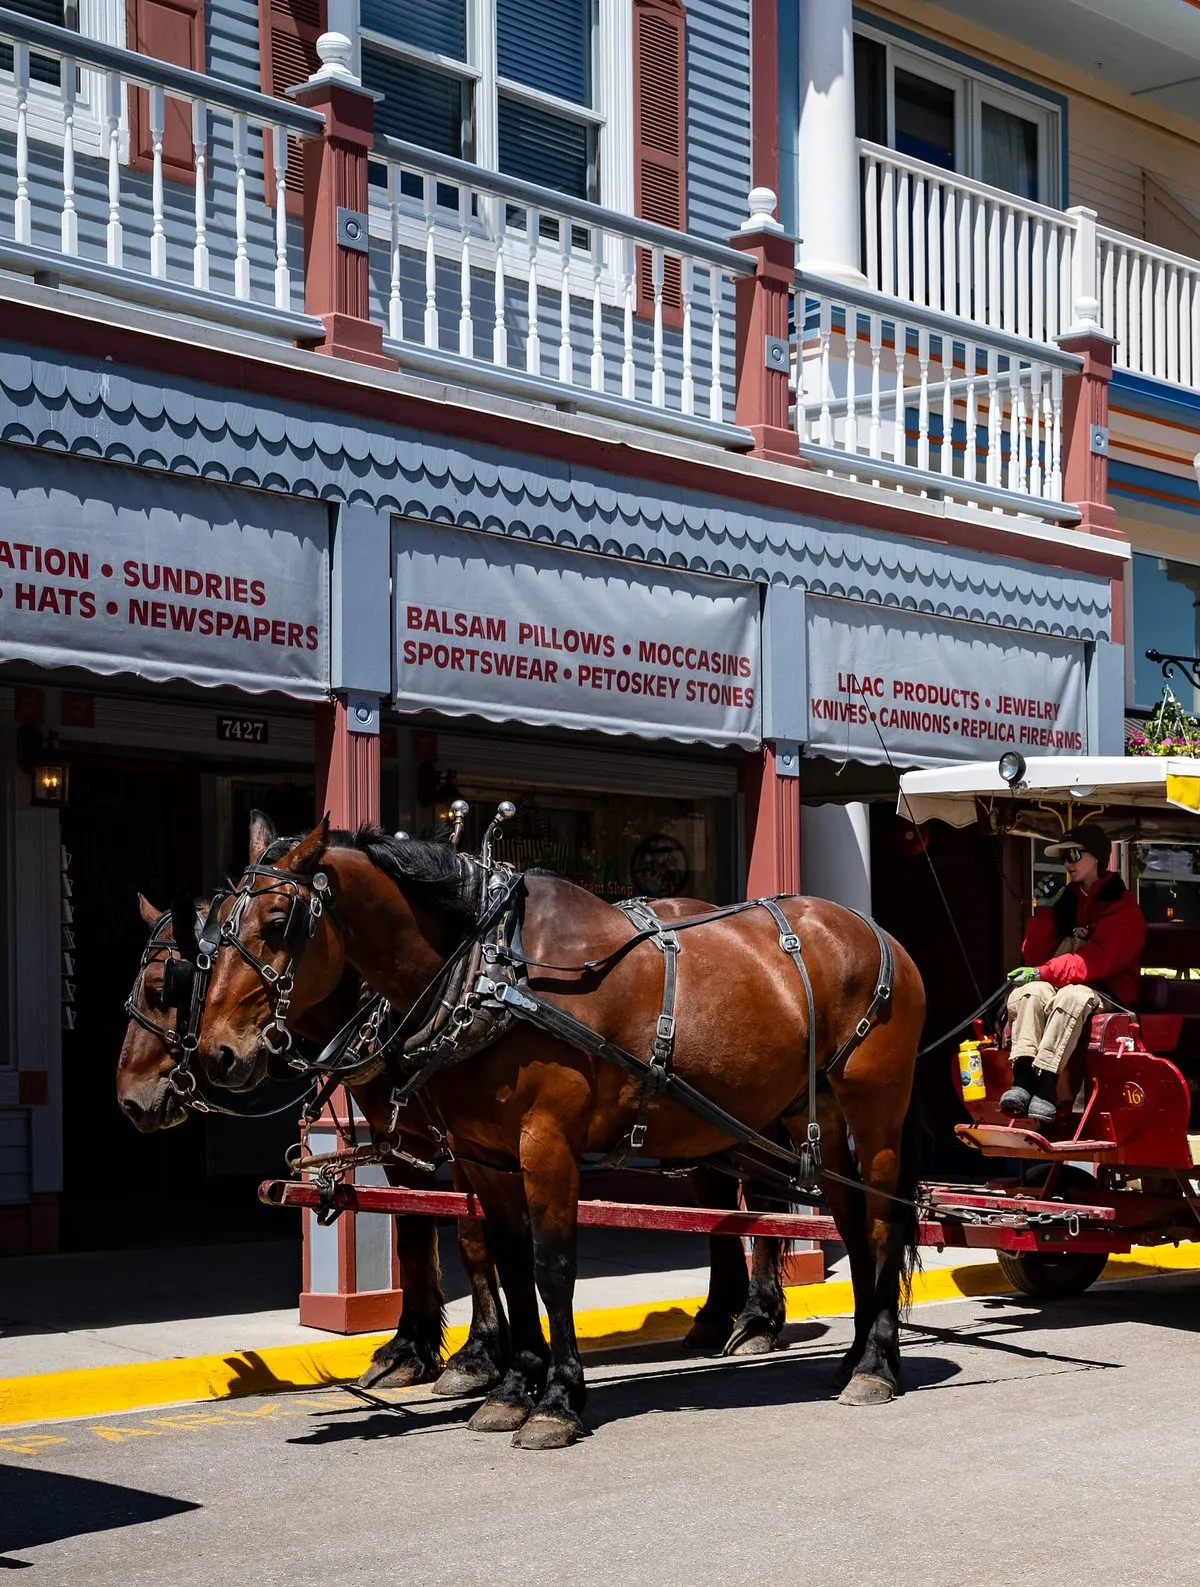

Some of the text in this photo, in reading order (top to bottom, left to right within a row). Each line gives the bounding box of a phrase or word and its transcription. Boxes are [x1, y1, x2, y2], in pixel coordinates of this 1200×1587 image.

[0, 541, 266, 606] ATION SUNDRIES
[15, 582, 319, 651] HATS NEWSPAPERS
[406, 606, 752, 679] BALSAM PILLOWS MOCCASINS
[403, 640, 754, 710] SPORTSWEAR PETOSKEY STONES
[838, 672, 1061, 722] LILAC PRODUCTS JEWELRY
[222, 719, 265, 740] 7427
[811, 699, 1083, 751] KNIVES CANNONS REPLICA FIREARMS
[1127, 1089, 1142, 1105] 16
